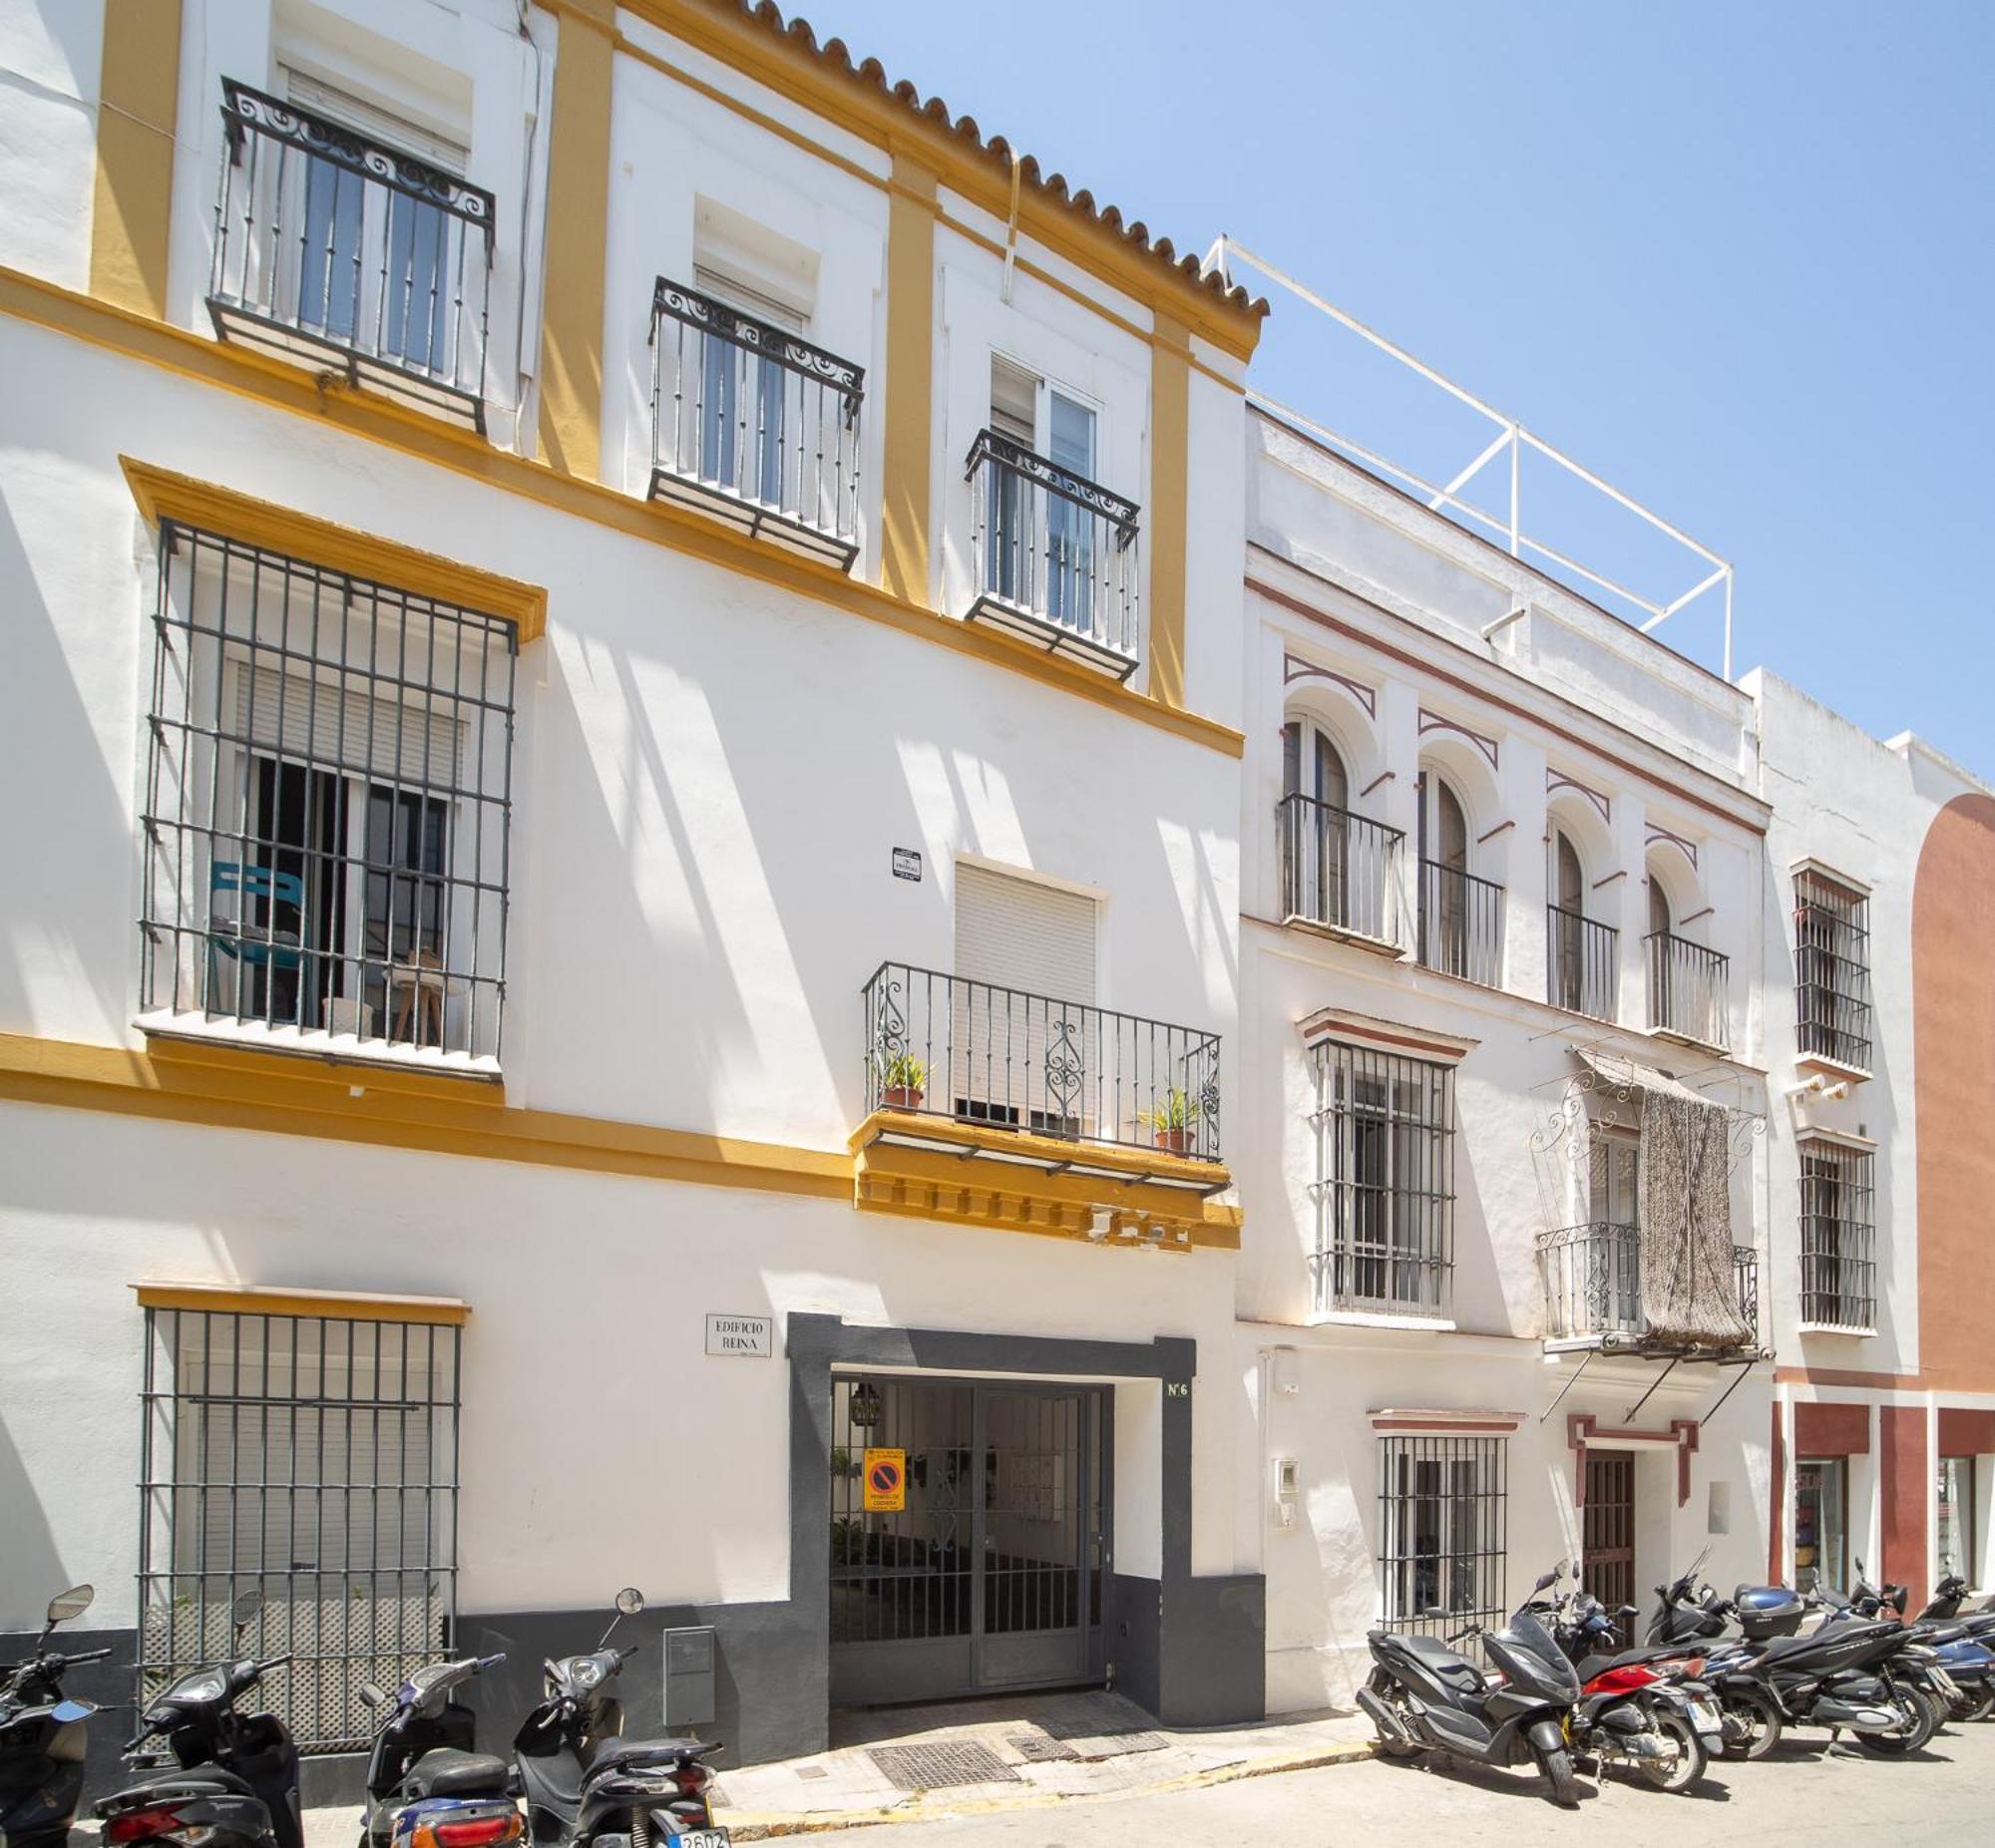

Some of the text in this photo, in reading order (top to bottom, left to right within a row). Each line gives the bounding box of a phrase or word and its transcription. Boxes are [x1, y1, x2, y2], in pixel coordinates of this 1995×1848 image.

[715, 1320, 763, 1334] EDIFICIO
[722, 1336, 758, 1349] REINA
[683, 1831, 724, 1848] 2602
